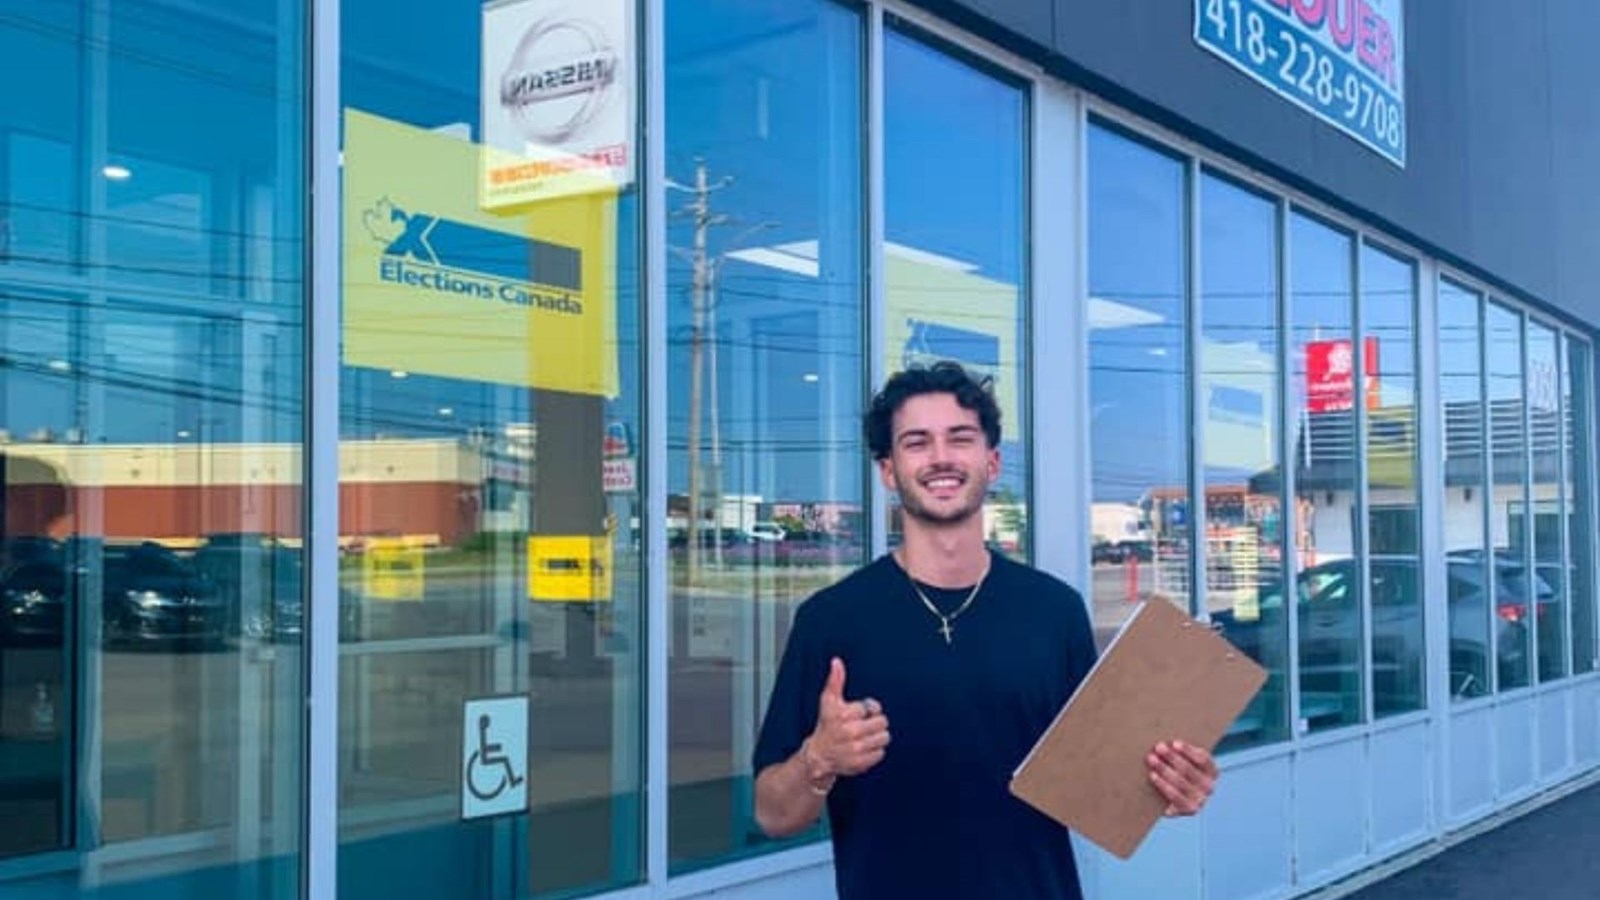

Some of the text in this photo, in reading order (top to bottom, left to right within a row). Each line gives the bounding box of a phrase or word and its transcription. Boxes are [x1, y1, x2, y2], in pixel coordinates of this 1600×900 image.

[1206, 0, 1399, 147] 418-228-9708
[1268, 0, 1399, 92] UER
[380, 261, 583, 315] Elections Canada
